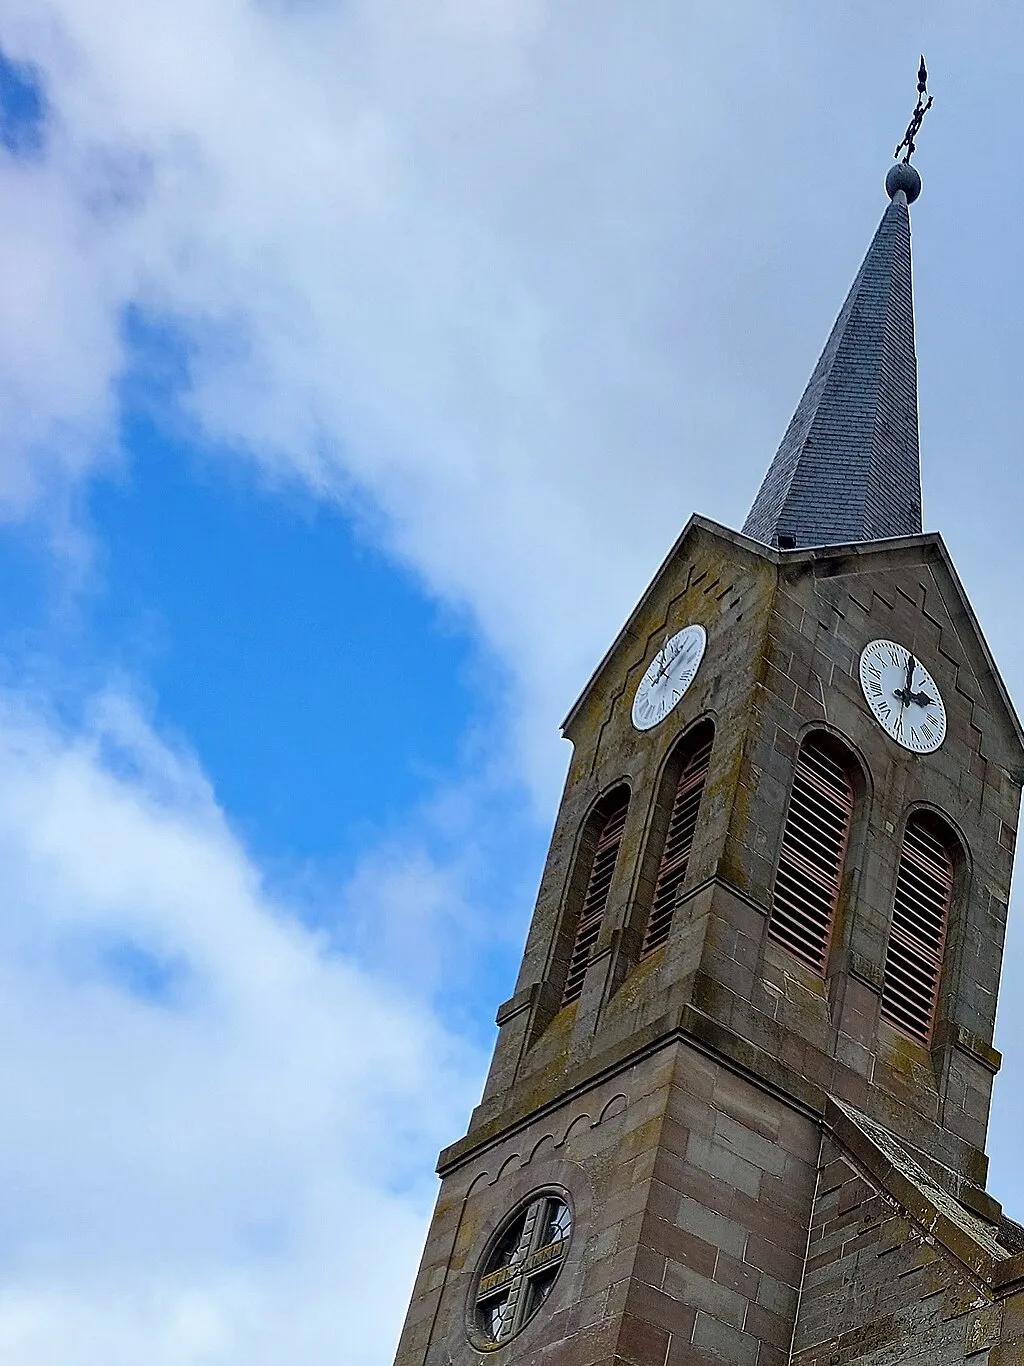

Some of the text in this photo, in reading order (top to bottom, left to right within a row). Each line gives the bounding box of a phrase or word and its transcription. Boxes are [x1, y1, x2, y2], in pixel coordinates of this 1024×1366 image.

[875, 652, 888, 668] X
[887, 650, 899, 667] XI
[878, 701, 891, 719] VII
